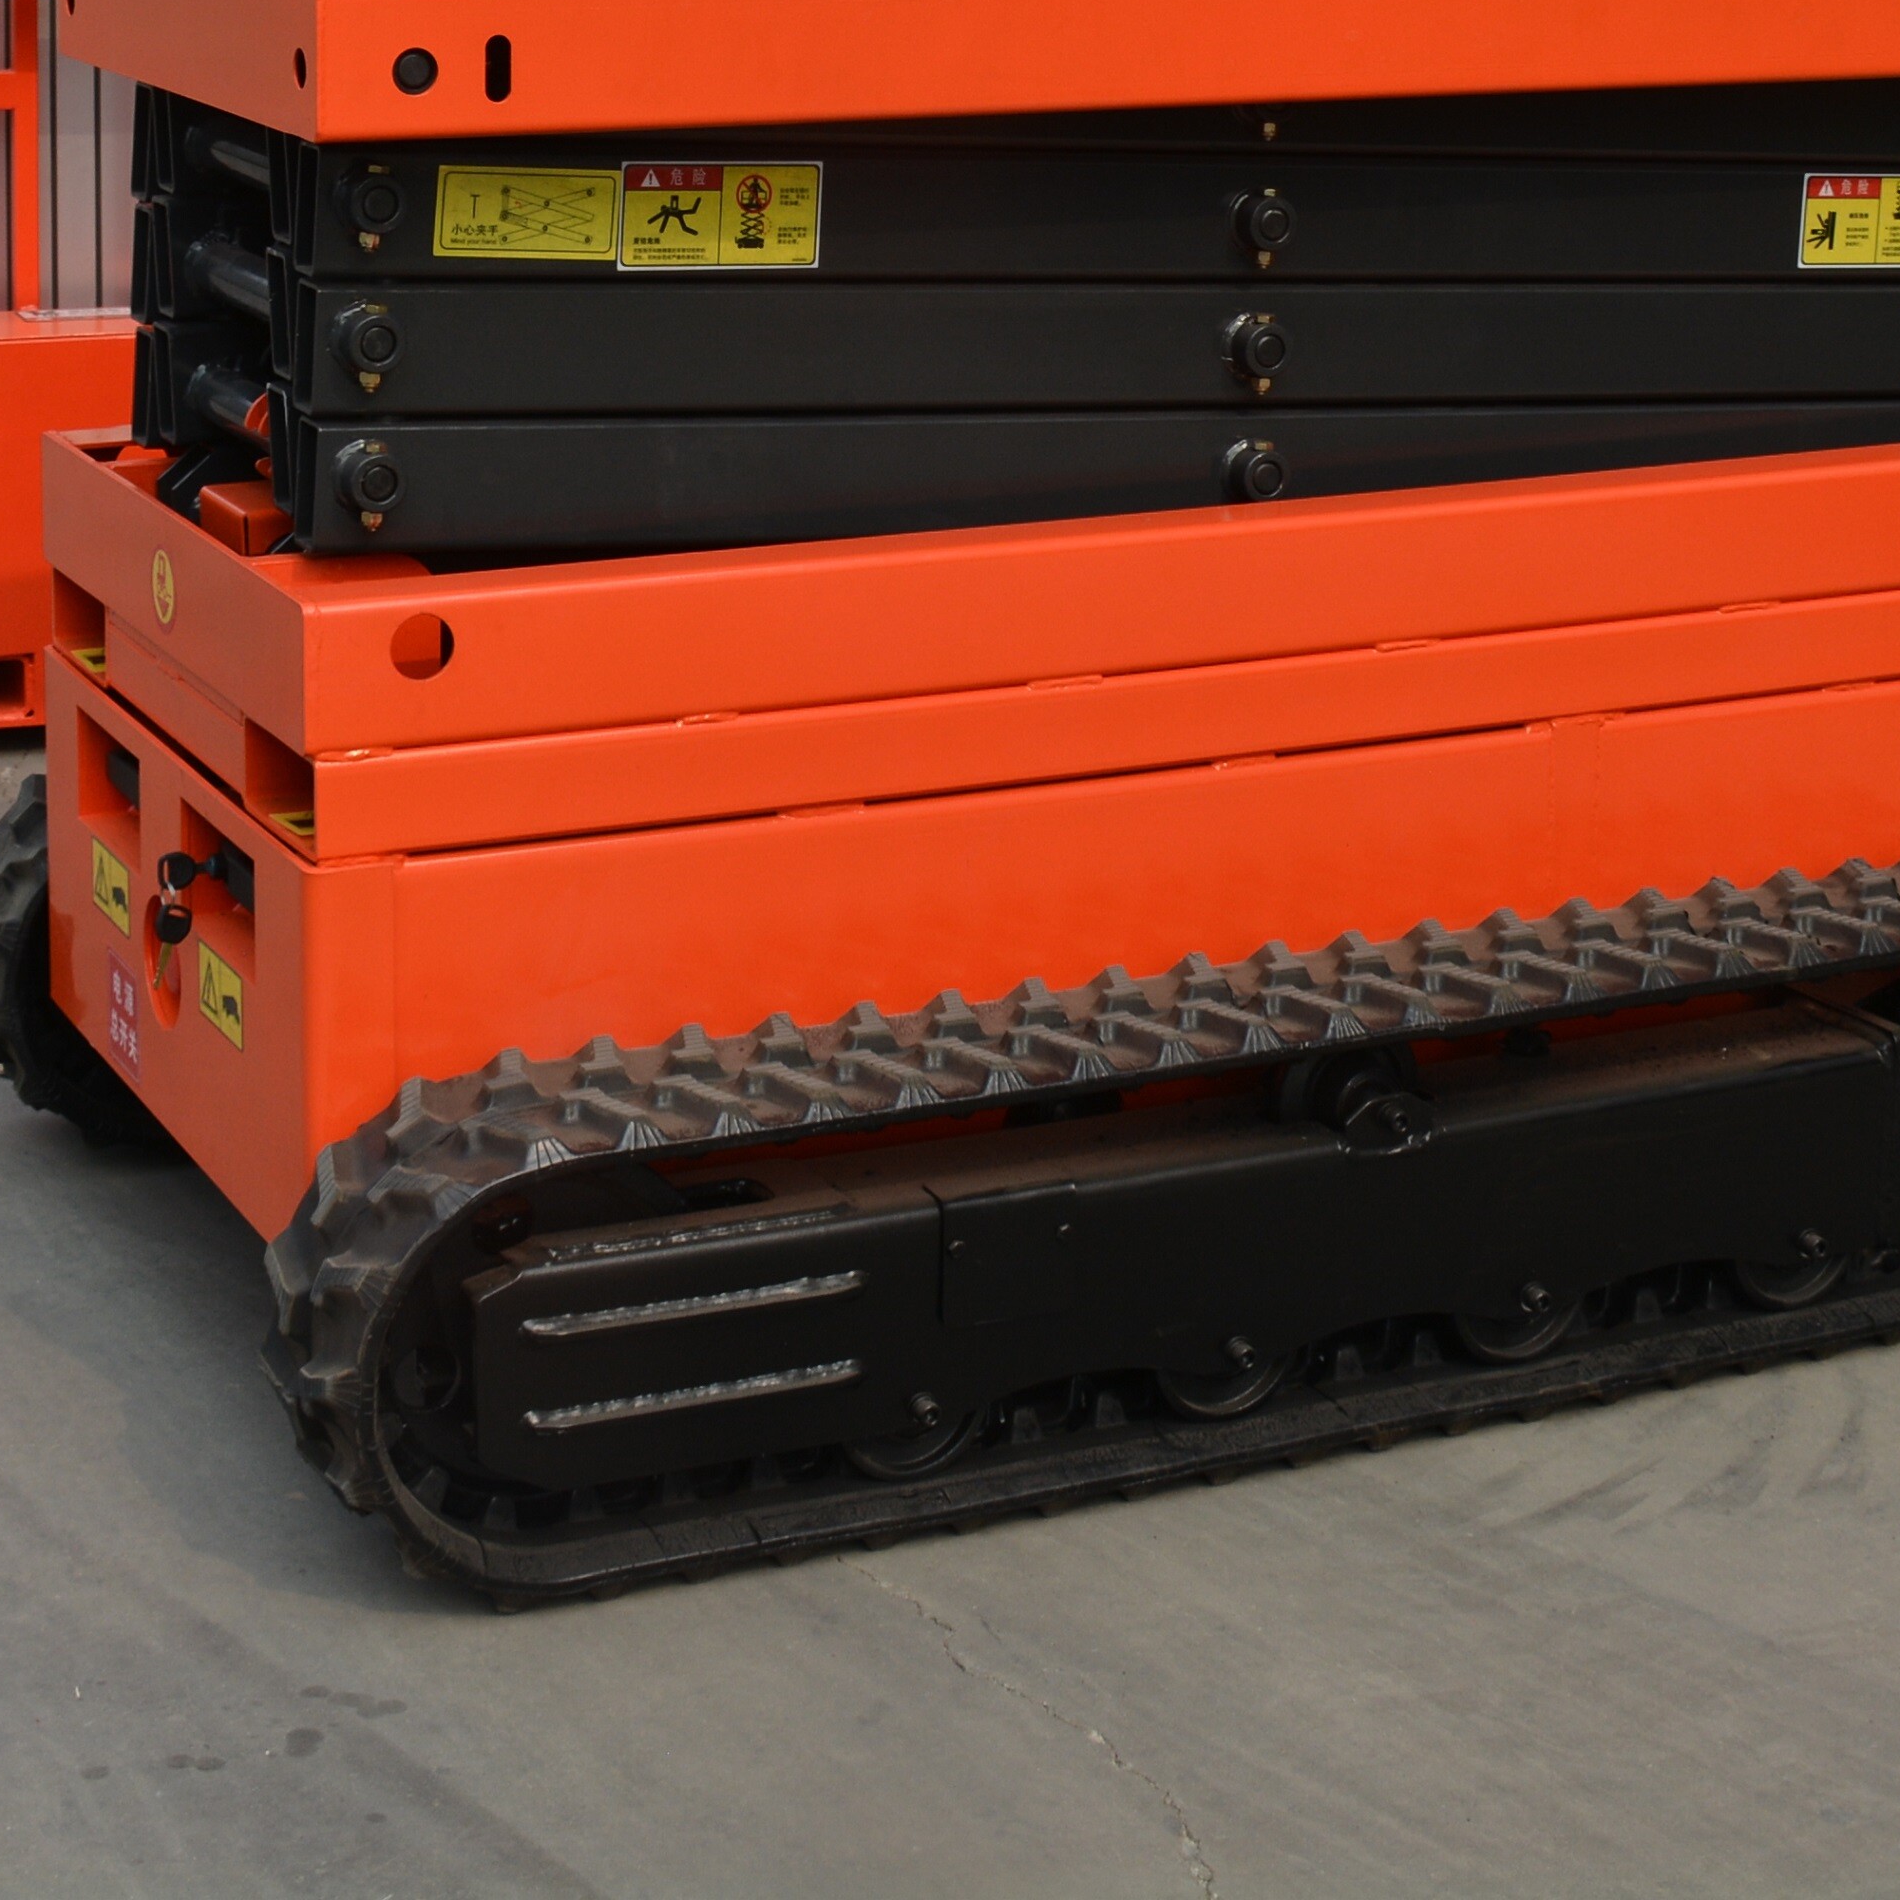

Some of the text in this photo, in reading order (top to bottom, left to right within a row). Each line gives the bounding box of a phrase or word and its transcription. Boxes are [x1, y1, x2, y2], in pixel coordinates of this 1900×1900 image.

[670, 168, 706, 186] 危险
[451, 224, 499, 237] 小心夹手
